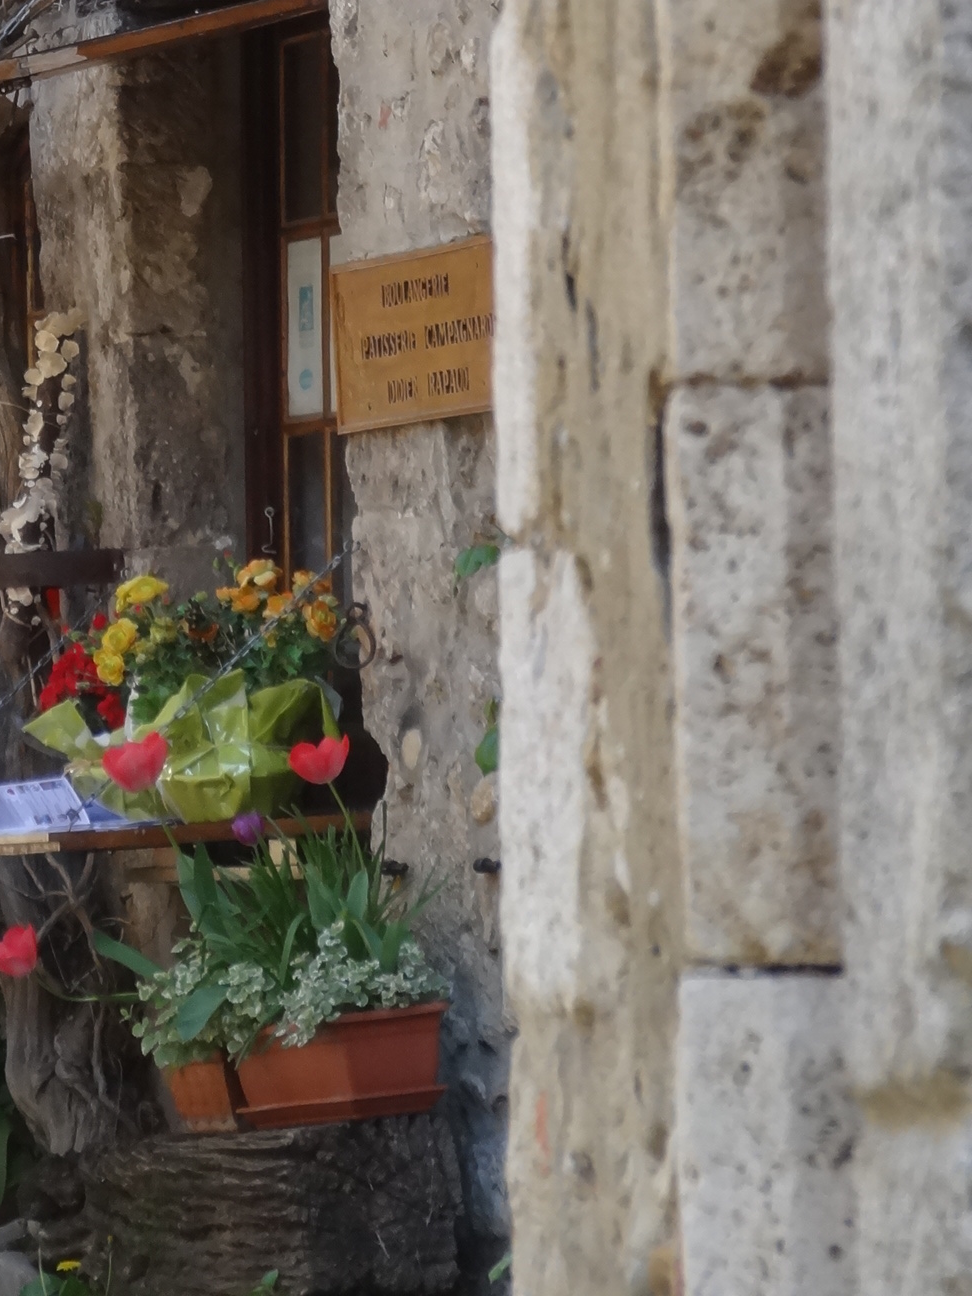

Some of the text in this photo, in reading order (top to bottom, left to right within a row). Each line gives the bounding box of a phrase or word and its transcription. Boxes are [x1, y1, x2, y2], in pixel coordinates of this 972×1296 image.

[381, 273, 450, 308] BOULANGERIE
[360, 313, 497, 360] PATISSERIE CAMPAGNARD
